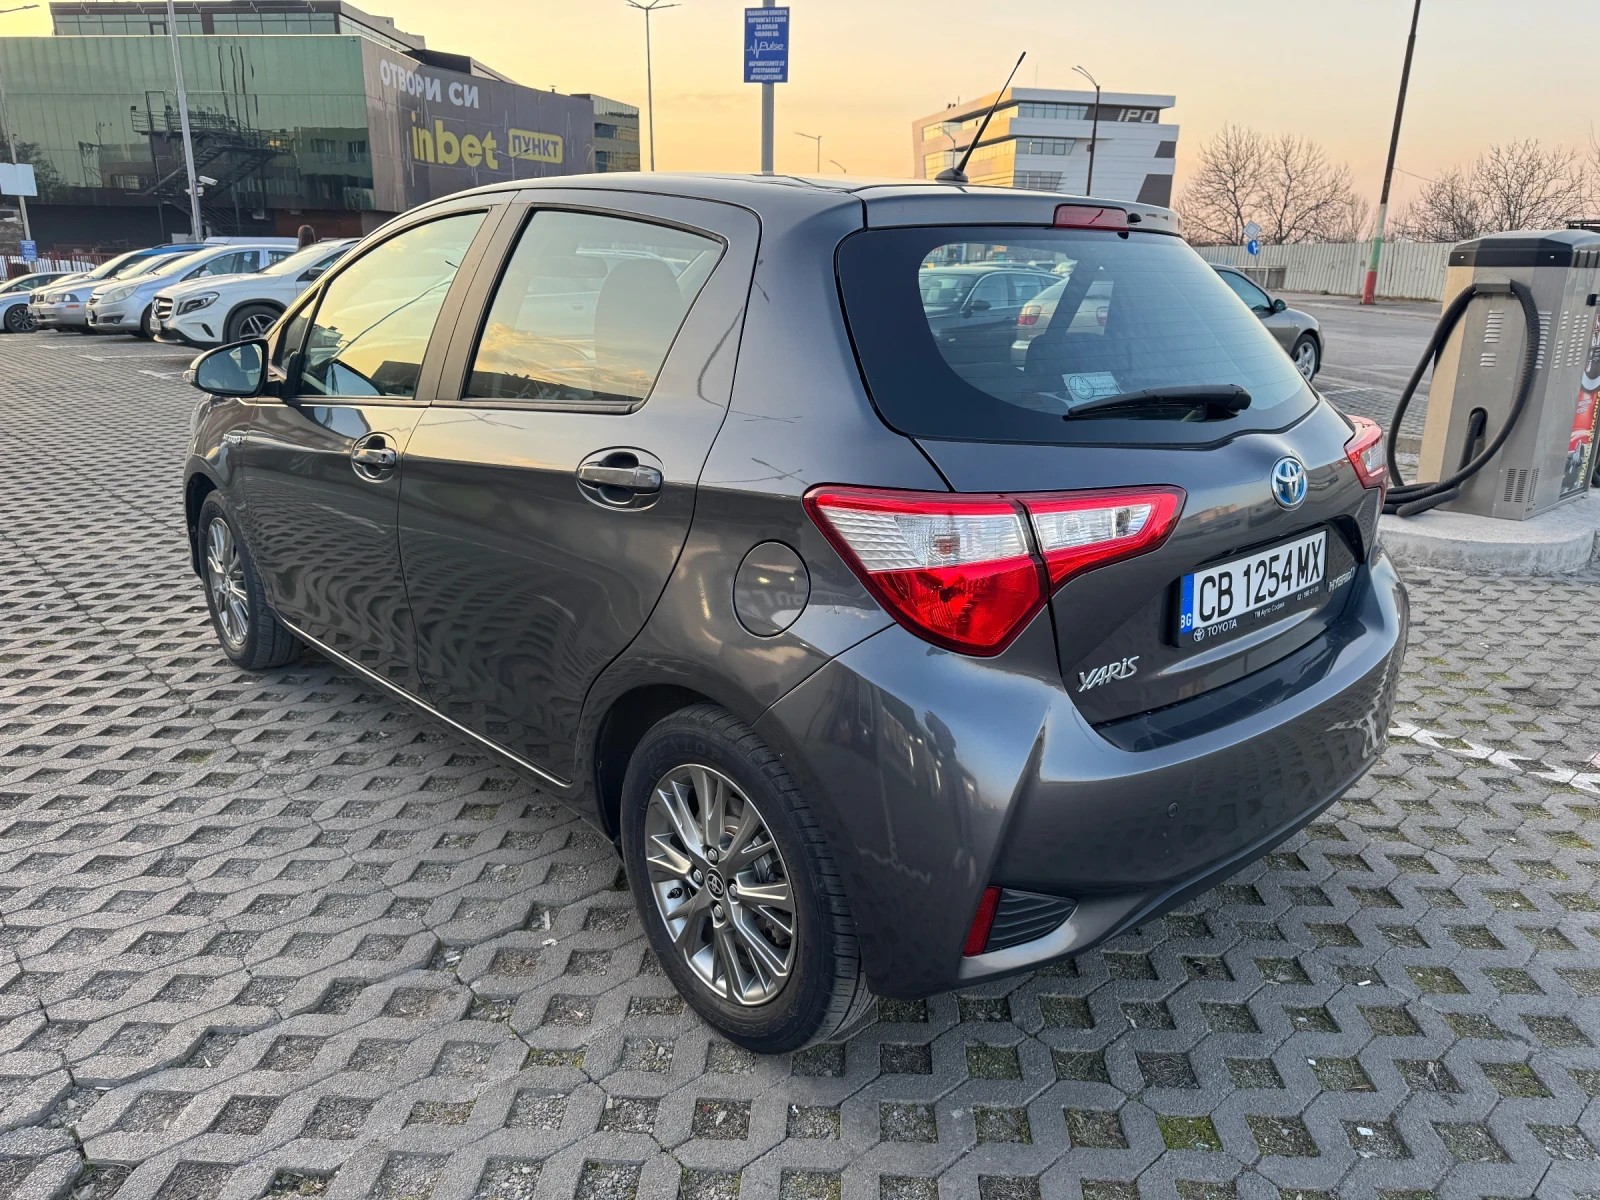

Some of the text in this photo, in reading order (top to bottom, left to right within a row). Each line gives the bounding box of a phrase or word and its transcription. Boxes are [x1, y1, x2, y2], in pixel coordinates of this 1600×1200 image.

[760, 41, 784, 50] Pulse
[380, 59, 480, 109] ОТВОРИ СИ
[1117, 108, 1157, 123] IPO
[411, 111, 499, 170] inbet
[511, 134, 560, 159] ПУНКТ
[1199, 538, 1323, 622] CB 1254 MX
[1180, 612, 1192, 629] BG
[1207, 619, 1237, 638] TOYOTA
[646, 737, 723, 765] DUNLOP
